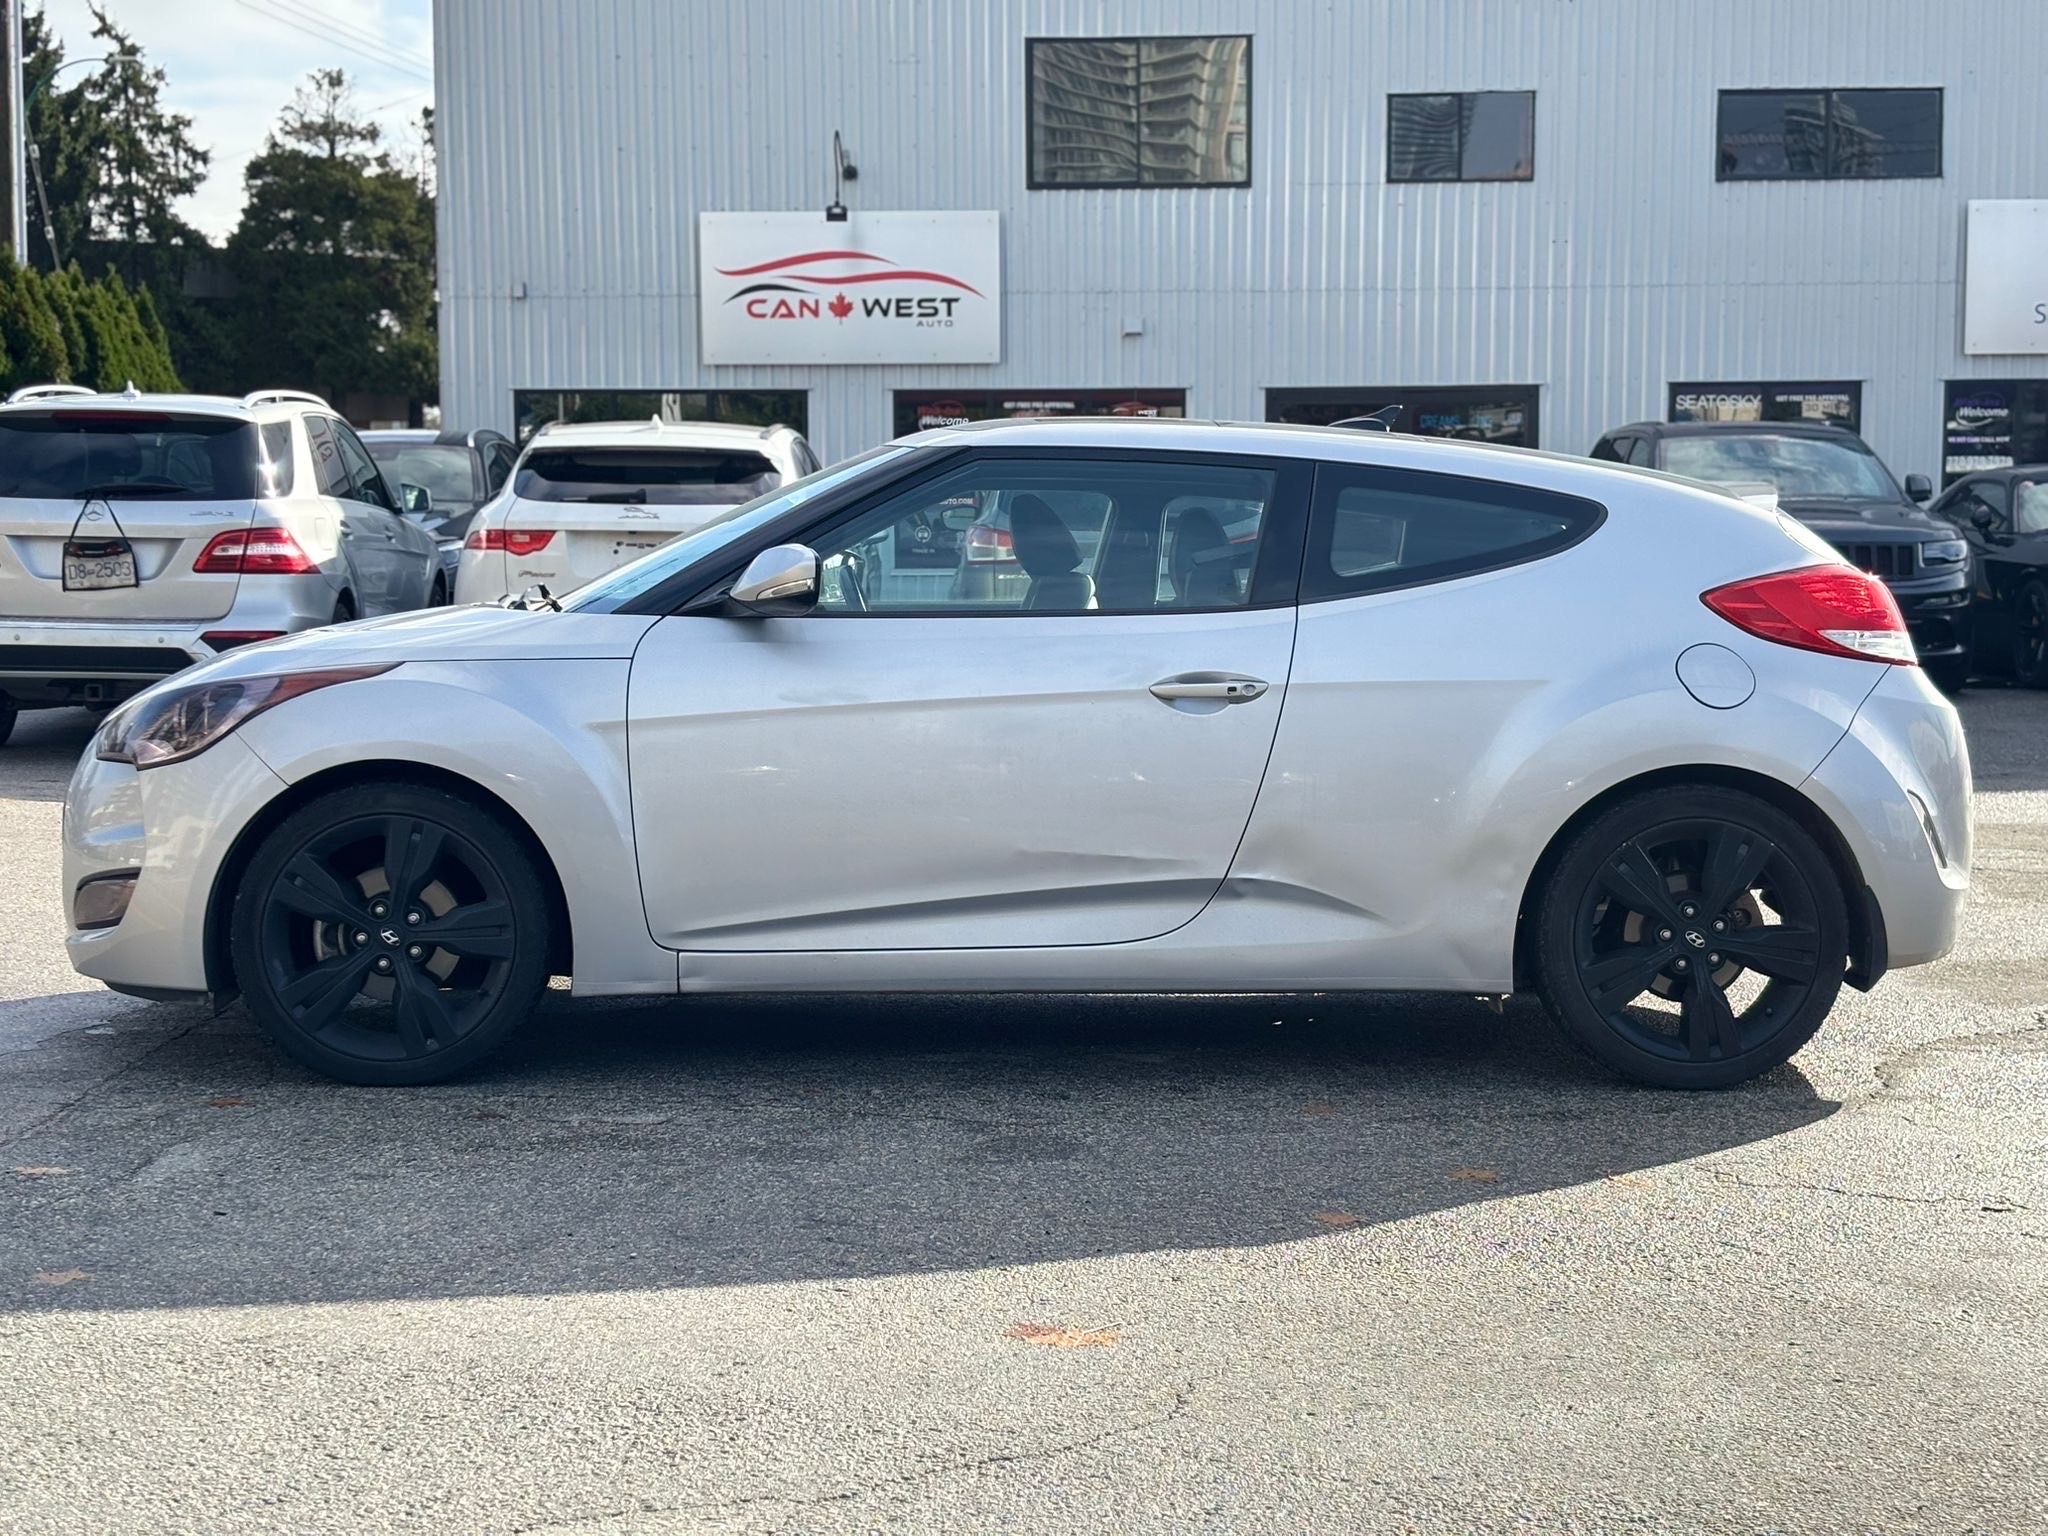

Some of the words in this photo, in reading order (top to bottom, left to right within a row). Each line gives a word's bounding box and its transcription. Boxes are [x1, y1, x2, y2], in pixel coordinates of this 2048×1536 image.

[746, 298, 820, 318] CAN
[861, 297, 961, 318] WEST
[916, 320, 953, 328] AUTO
[1675, 394, 1762, 410] SEATOSKY
[1959, 406, 2009, 417] Welcome
[922, 415, 969, 426] Welcome
